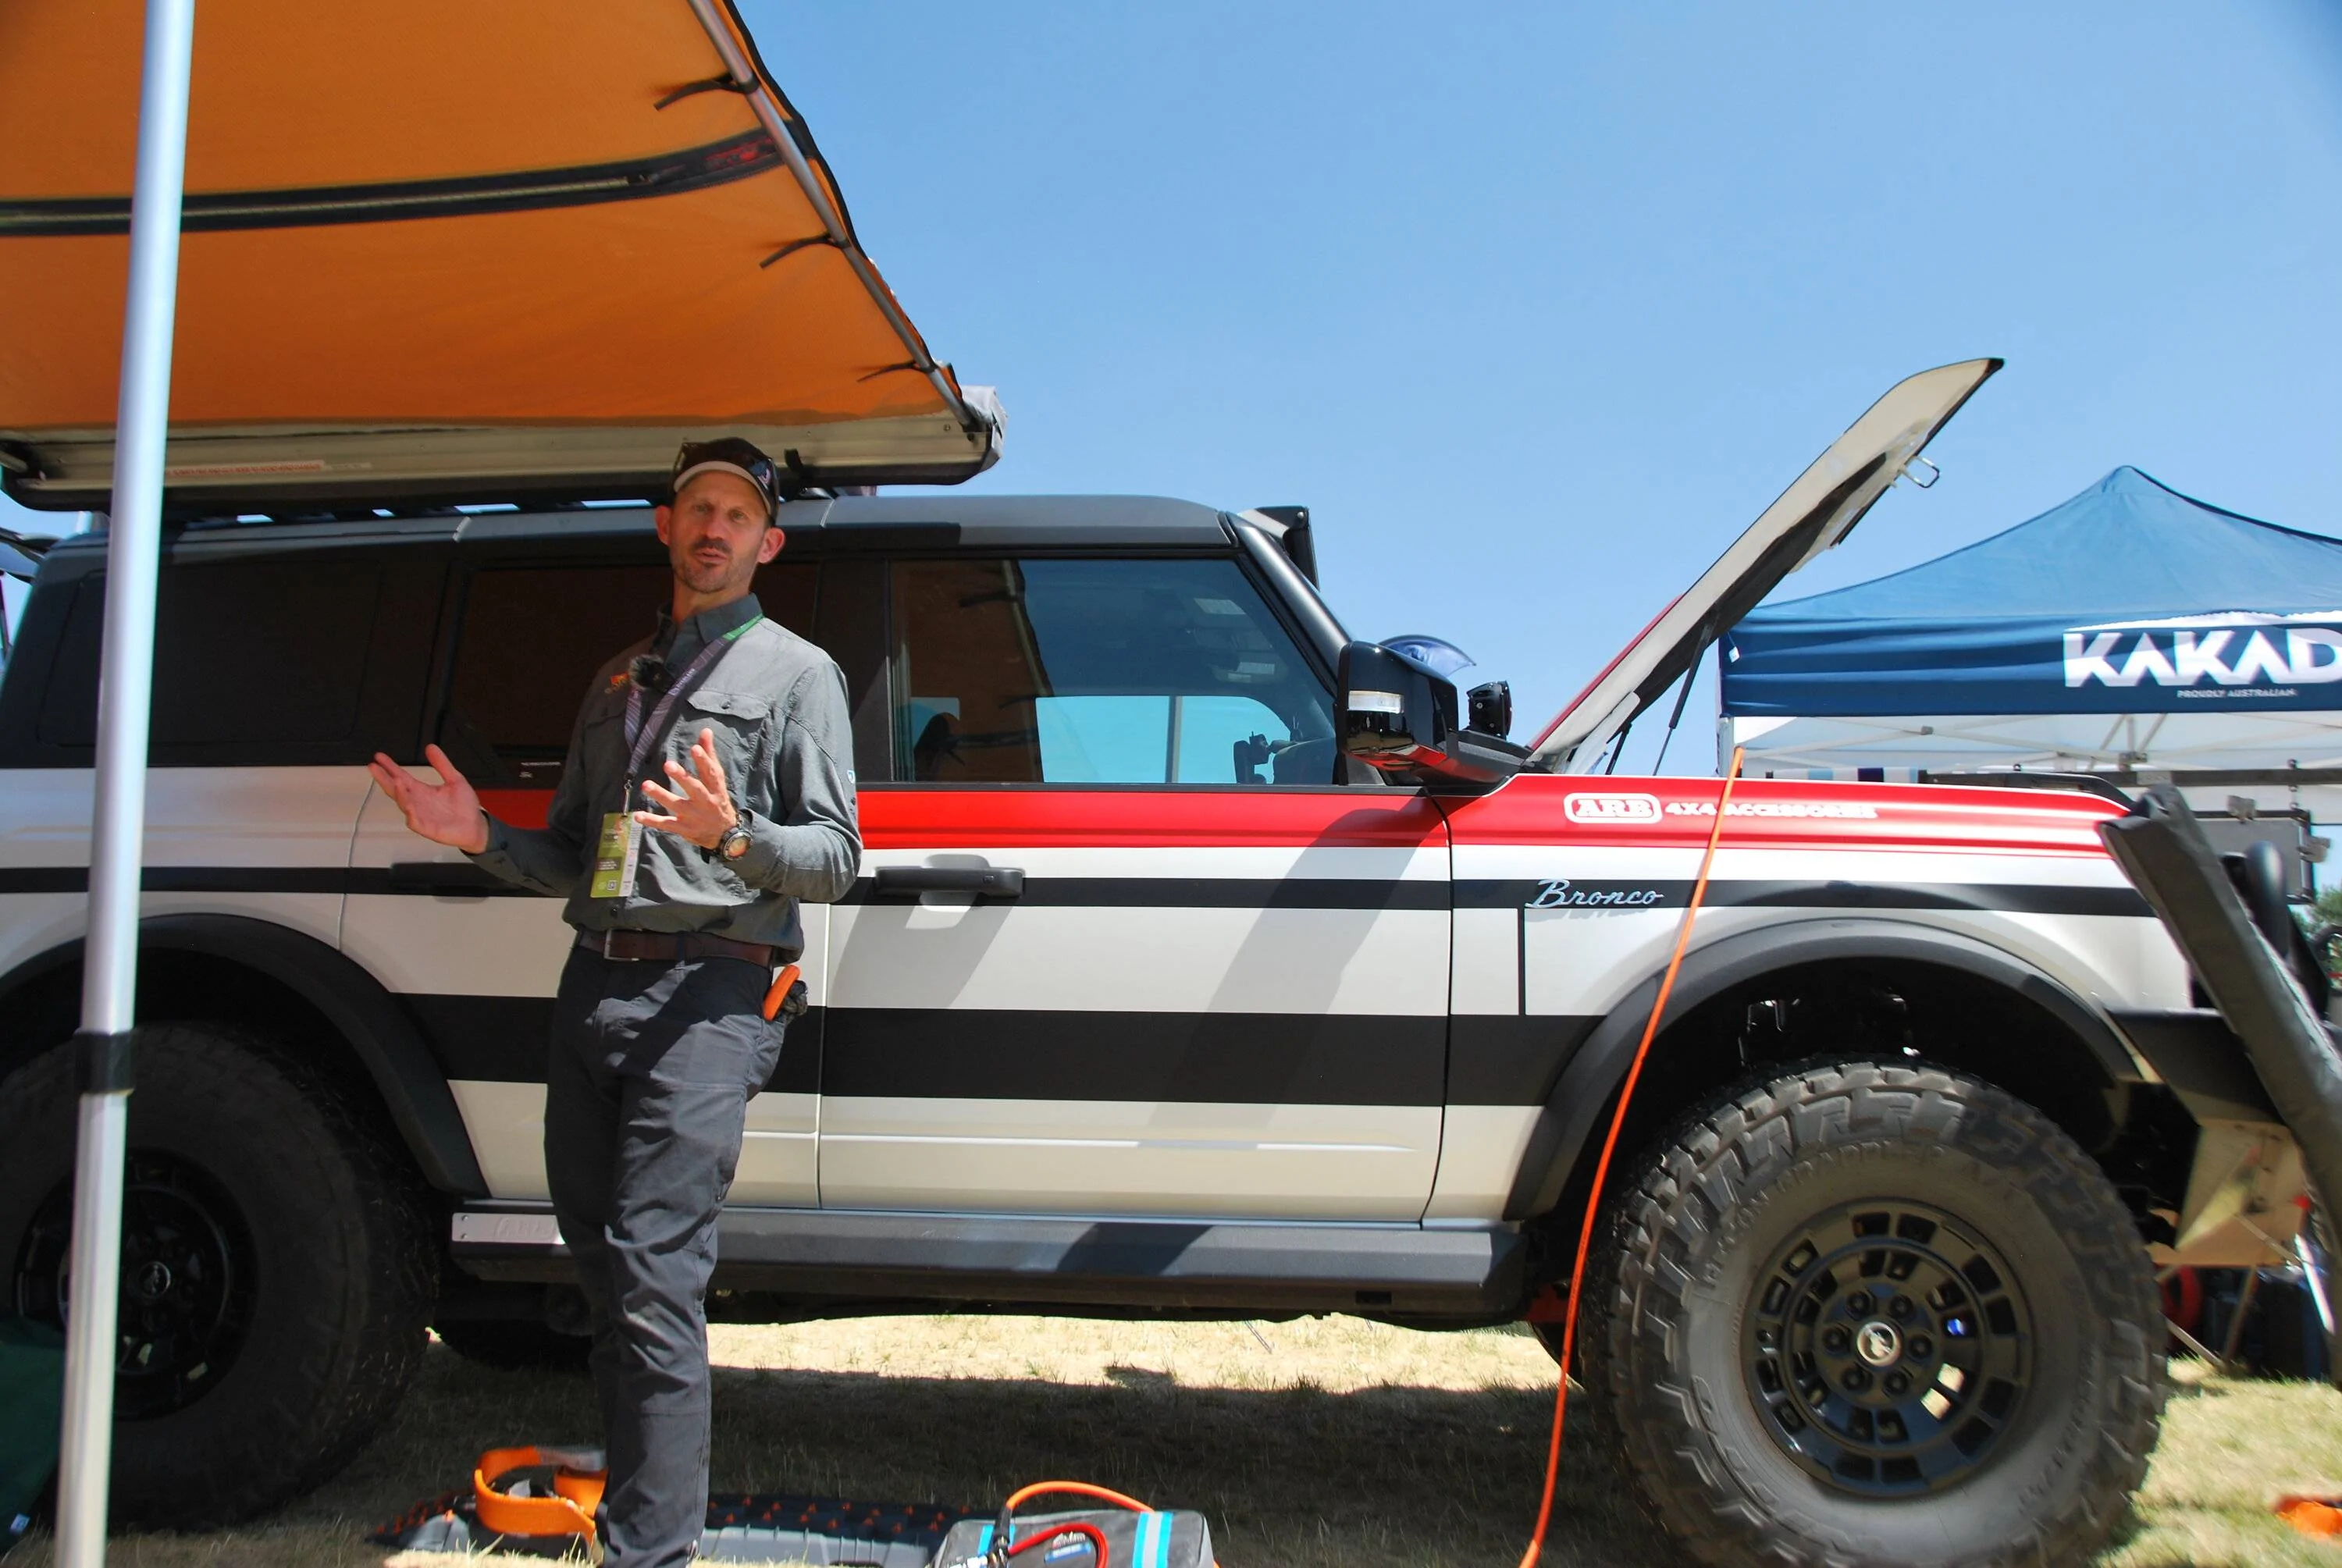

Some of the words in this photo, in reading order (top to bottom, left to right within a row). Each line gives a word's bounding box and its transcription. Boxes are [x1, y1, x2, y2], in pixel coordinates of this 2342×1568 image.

[2063, 628, 2342, 687] KAKAD
[2176, 690, 2224, 699] PROUDLY
[2226, 688, 2298, 698] AUSTRALIAN
[1575, 798, 1653, 817] ARB
[1664, 802, 1717, 816] 4X4
[1525, 879, 1664, 908] Bronco
